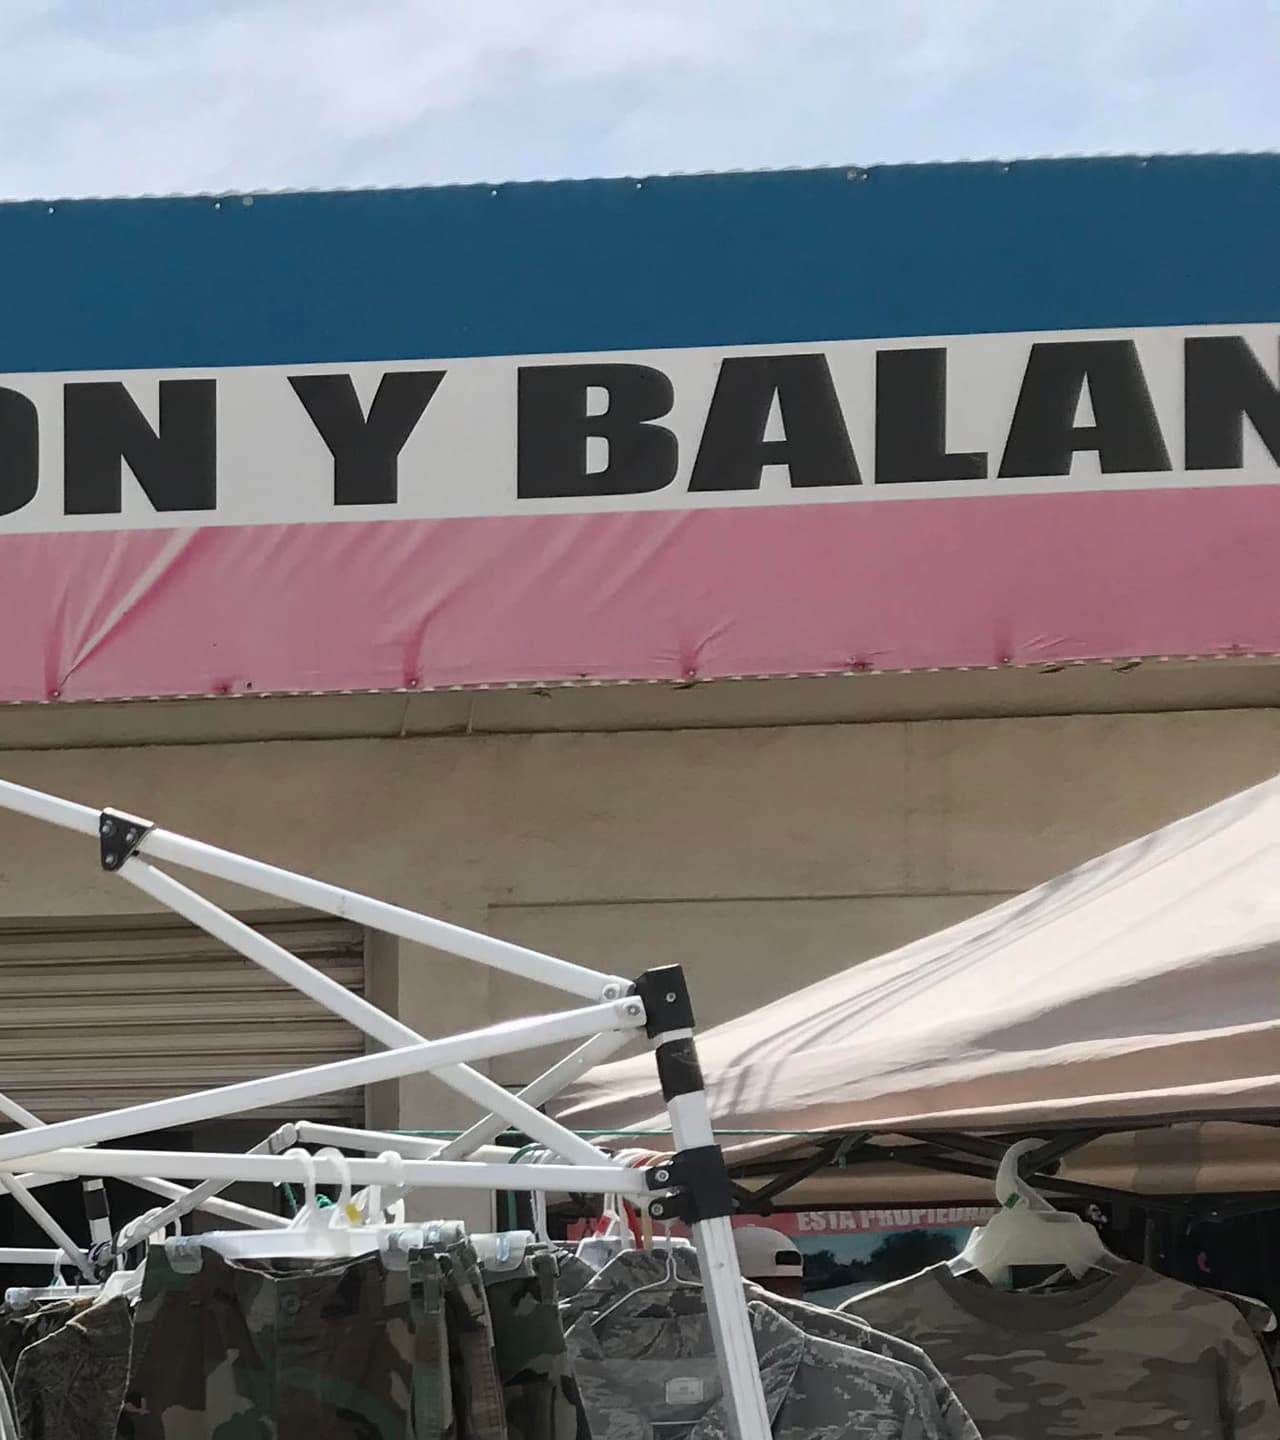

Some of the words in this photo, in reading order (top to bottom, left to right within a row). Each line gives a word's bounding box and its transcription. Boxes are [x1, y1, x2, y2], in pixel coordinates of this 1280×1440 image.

[287, 371, 446, 505] Y
[517, 336, 1280, 499] BALAN
[796, 1211, 857, 1231] ESTA
